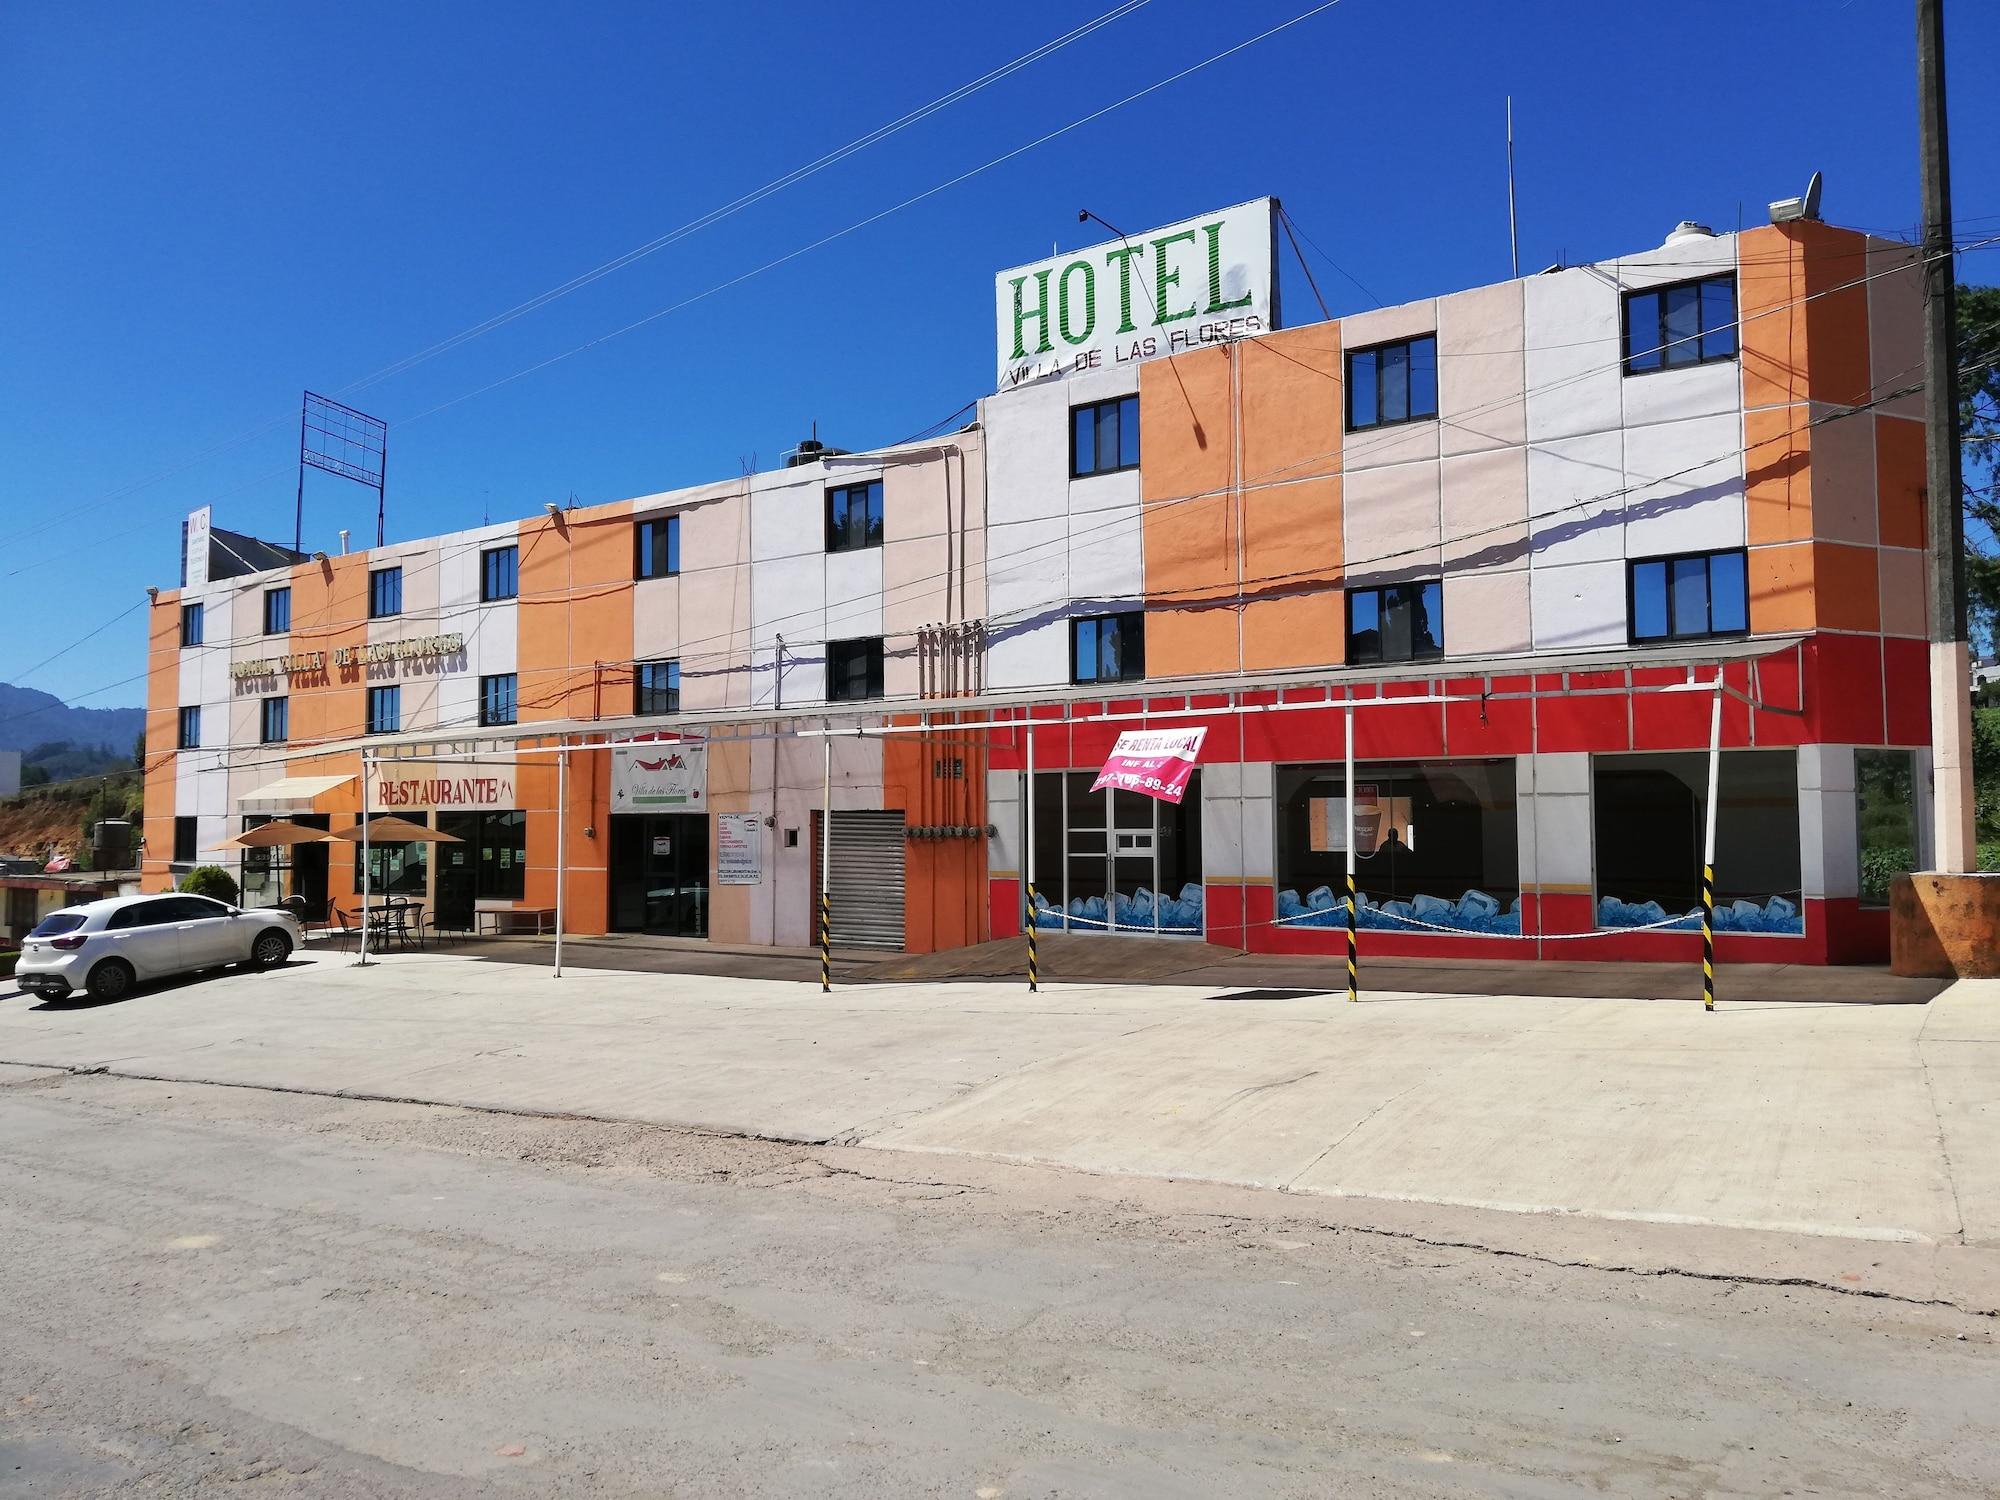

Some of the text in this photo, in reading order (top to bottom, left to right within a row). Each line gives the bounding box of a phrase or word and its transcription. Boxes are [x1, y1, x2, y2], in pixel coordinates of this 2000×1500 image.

[1008, 220, 1253, 360] HOTEL
[1009, 315, 1262, 386] VILLA DE LAS FLORES
[279, 650, 323, 673] VILLA
[334, 646, 352, 667] DE
[356, 642, 391, 665] LAS
[391, 632, 463, 661] FLORES
[1114, 735, 1198, 753] SE RENTA LOCAL
[1121, 759, 1142, 768] INF
[378, 778, 498, 806] RESTAURANTE
